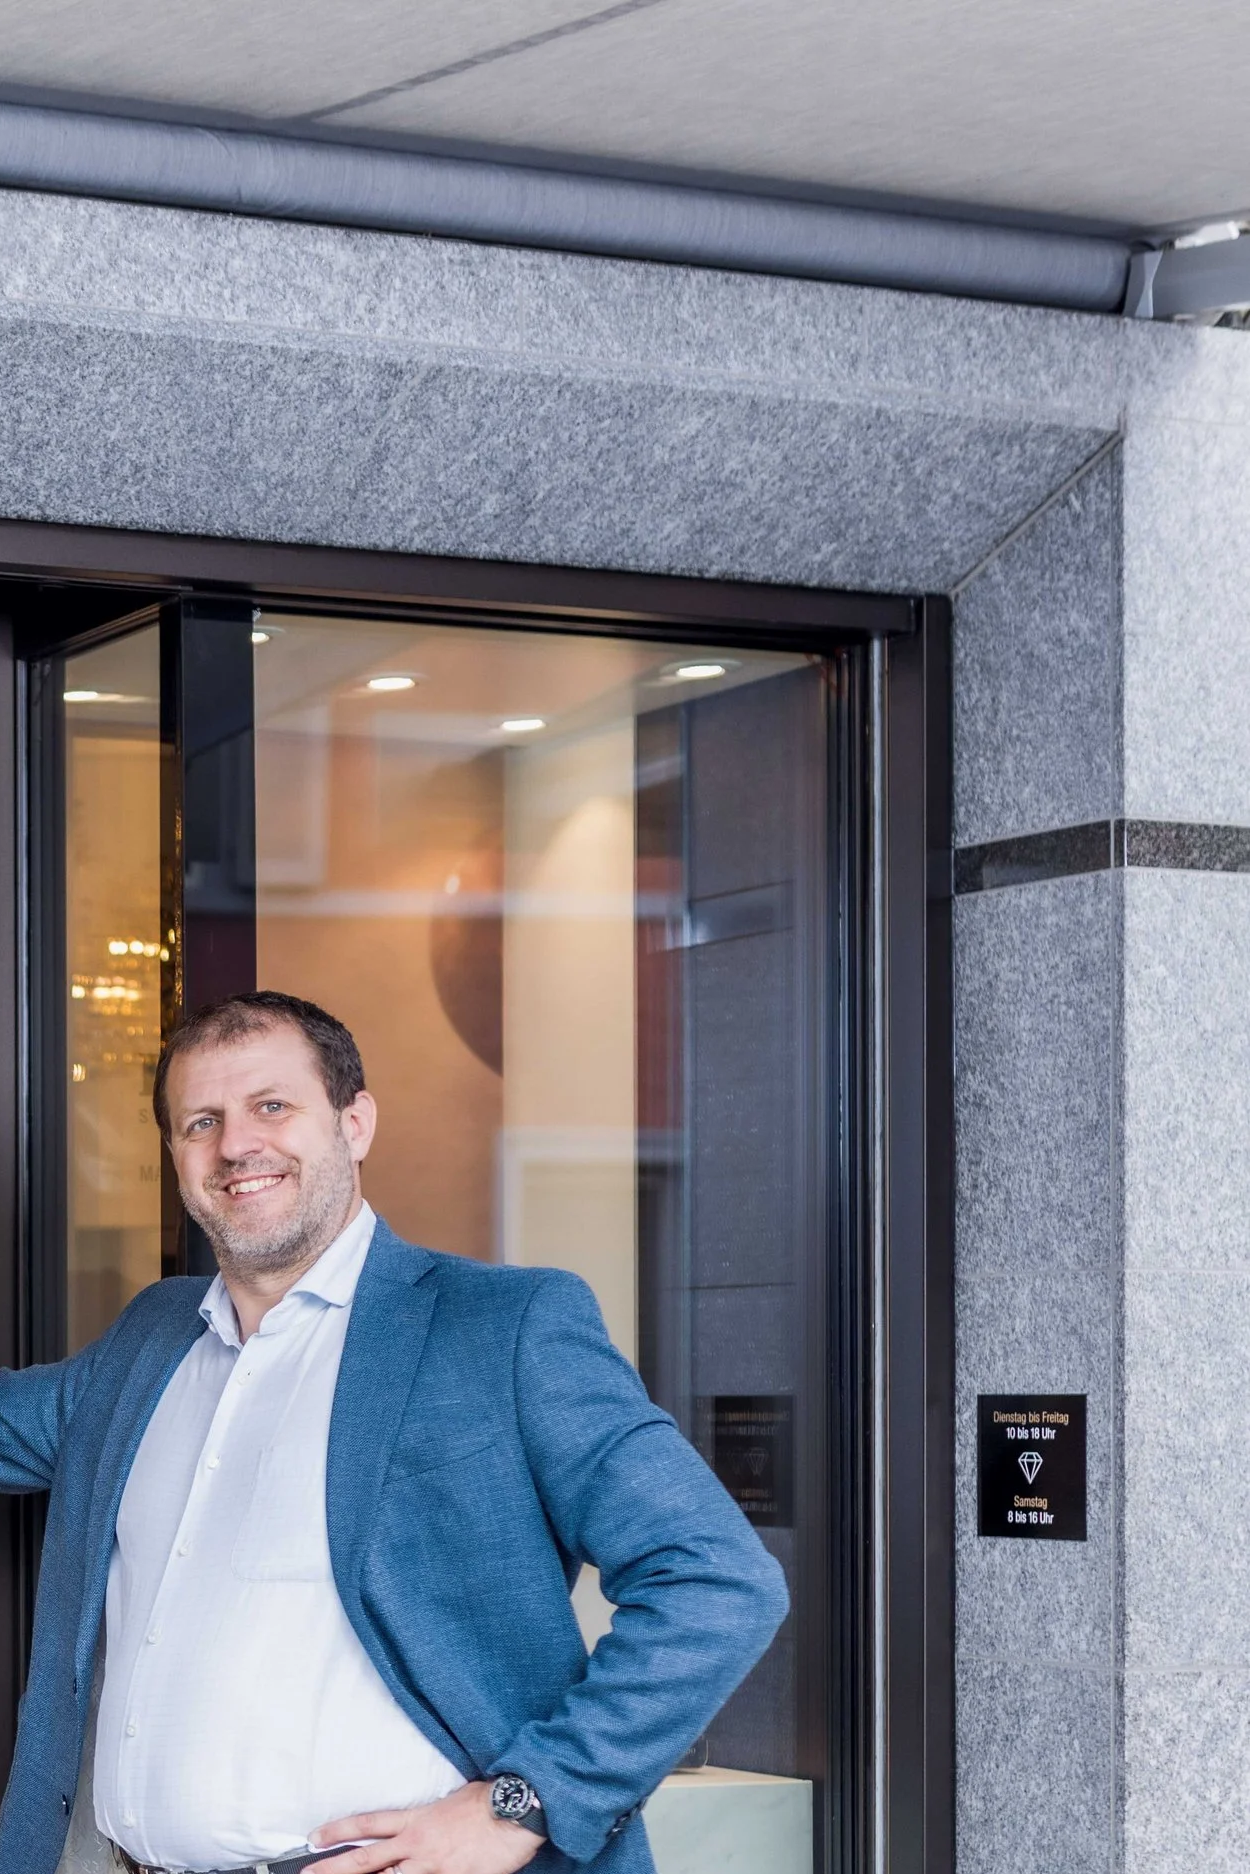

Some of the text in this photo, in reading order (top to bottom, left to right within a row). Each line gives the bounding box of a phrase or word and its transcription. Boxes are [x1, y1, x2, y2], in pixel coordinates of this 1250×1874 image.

[993, 1410, 1069, 1426] Dienstag bis Freitag
[1006, 1427, 1056, 1440] 10 bis 18 Uhr
[1013, 1494, 1048, 1510] Samstag
[1007, 1510, 1054, 1524] 8 bis 16 Uhr
